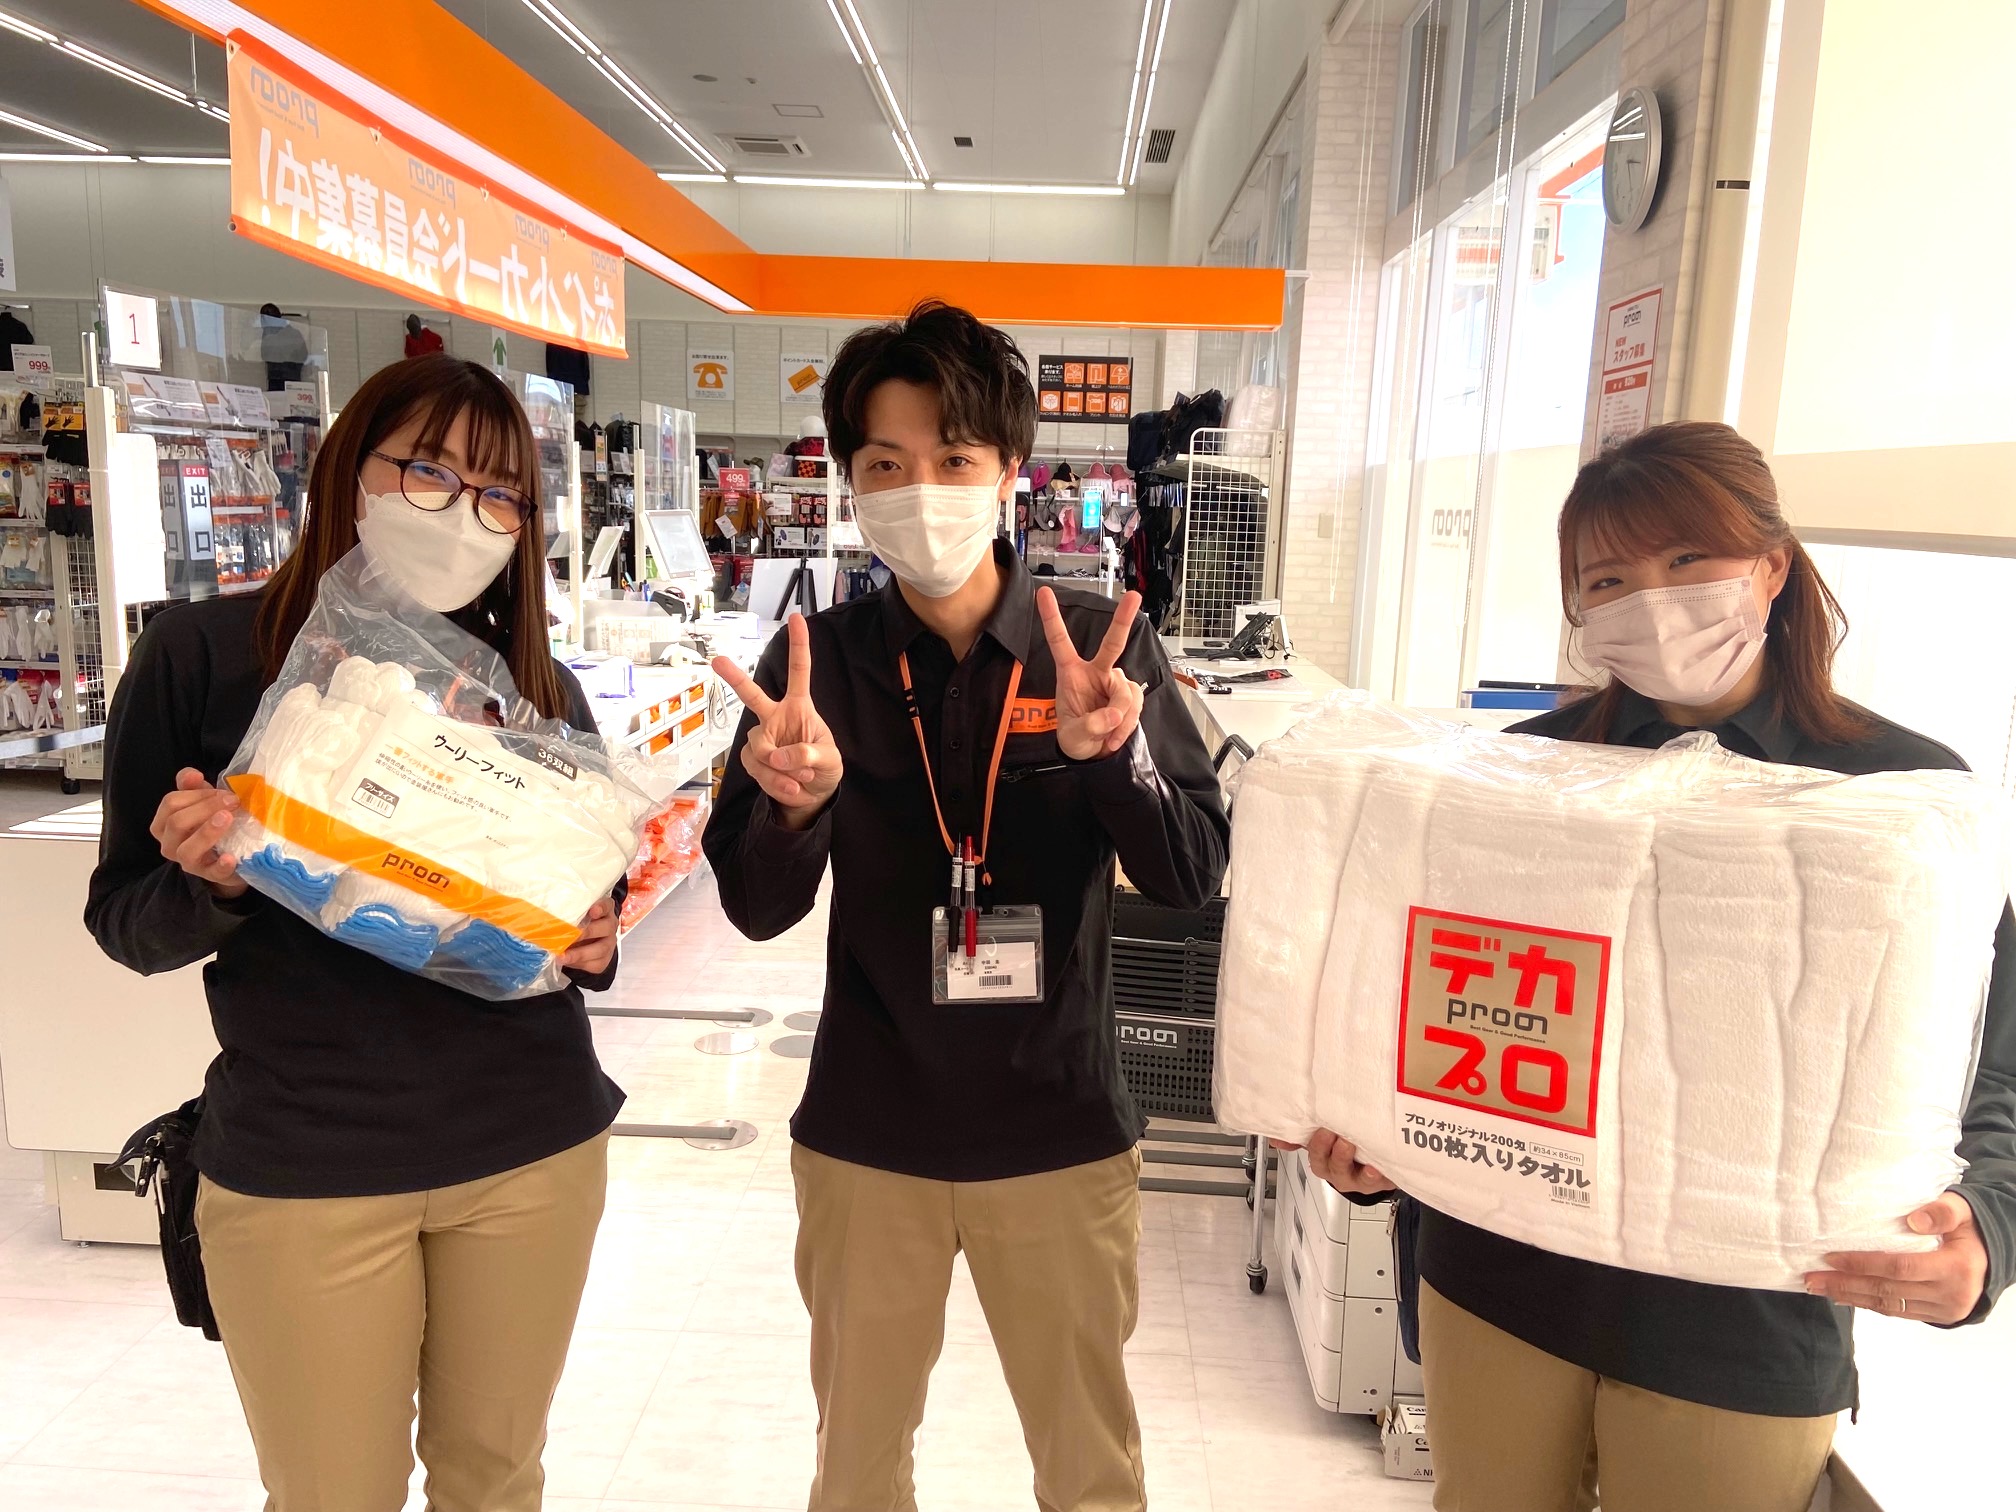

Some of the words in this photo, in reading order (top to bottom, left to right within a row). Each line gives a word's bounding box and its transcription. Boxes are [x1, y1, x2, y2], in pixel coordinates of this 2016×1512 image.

[129, 313, 140, 345] 1
[185, 467, 206, 476] EXIT
[190, 483, 211, 553] 出口
[1009, 706, 1057, 729] pro
[434, 734, 525, 789] ウーリーフィット
[538, 747, 574, 778] 36双組
[365, 782, 396, 803] フリーサイズ
[1430, 928, 1576, 1015] デカ
[1424, 1024, 1568, 1113] プロ
[1401, 1127, 1591, 1188] 100枚入りタオル
